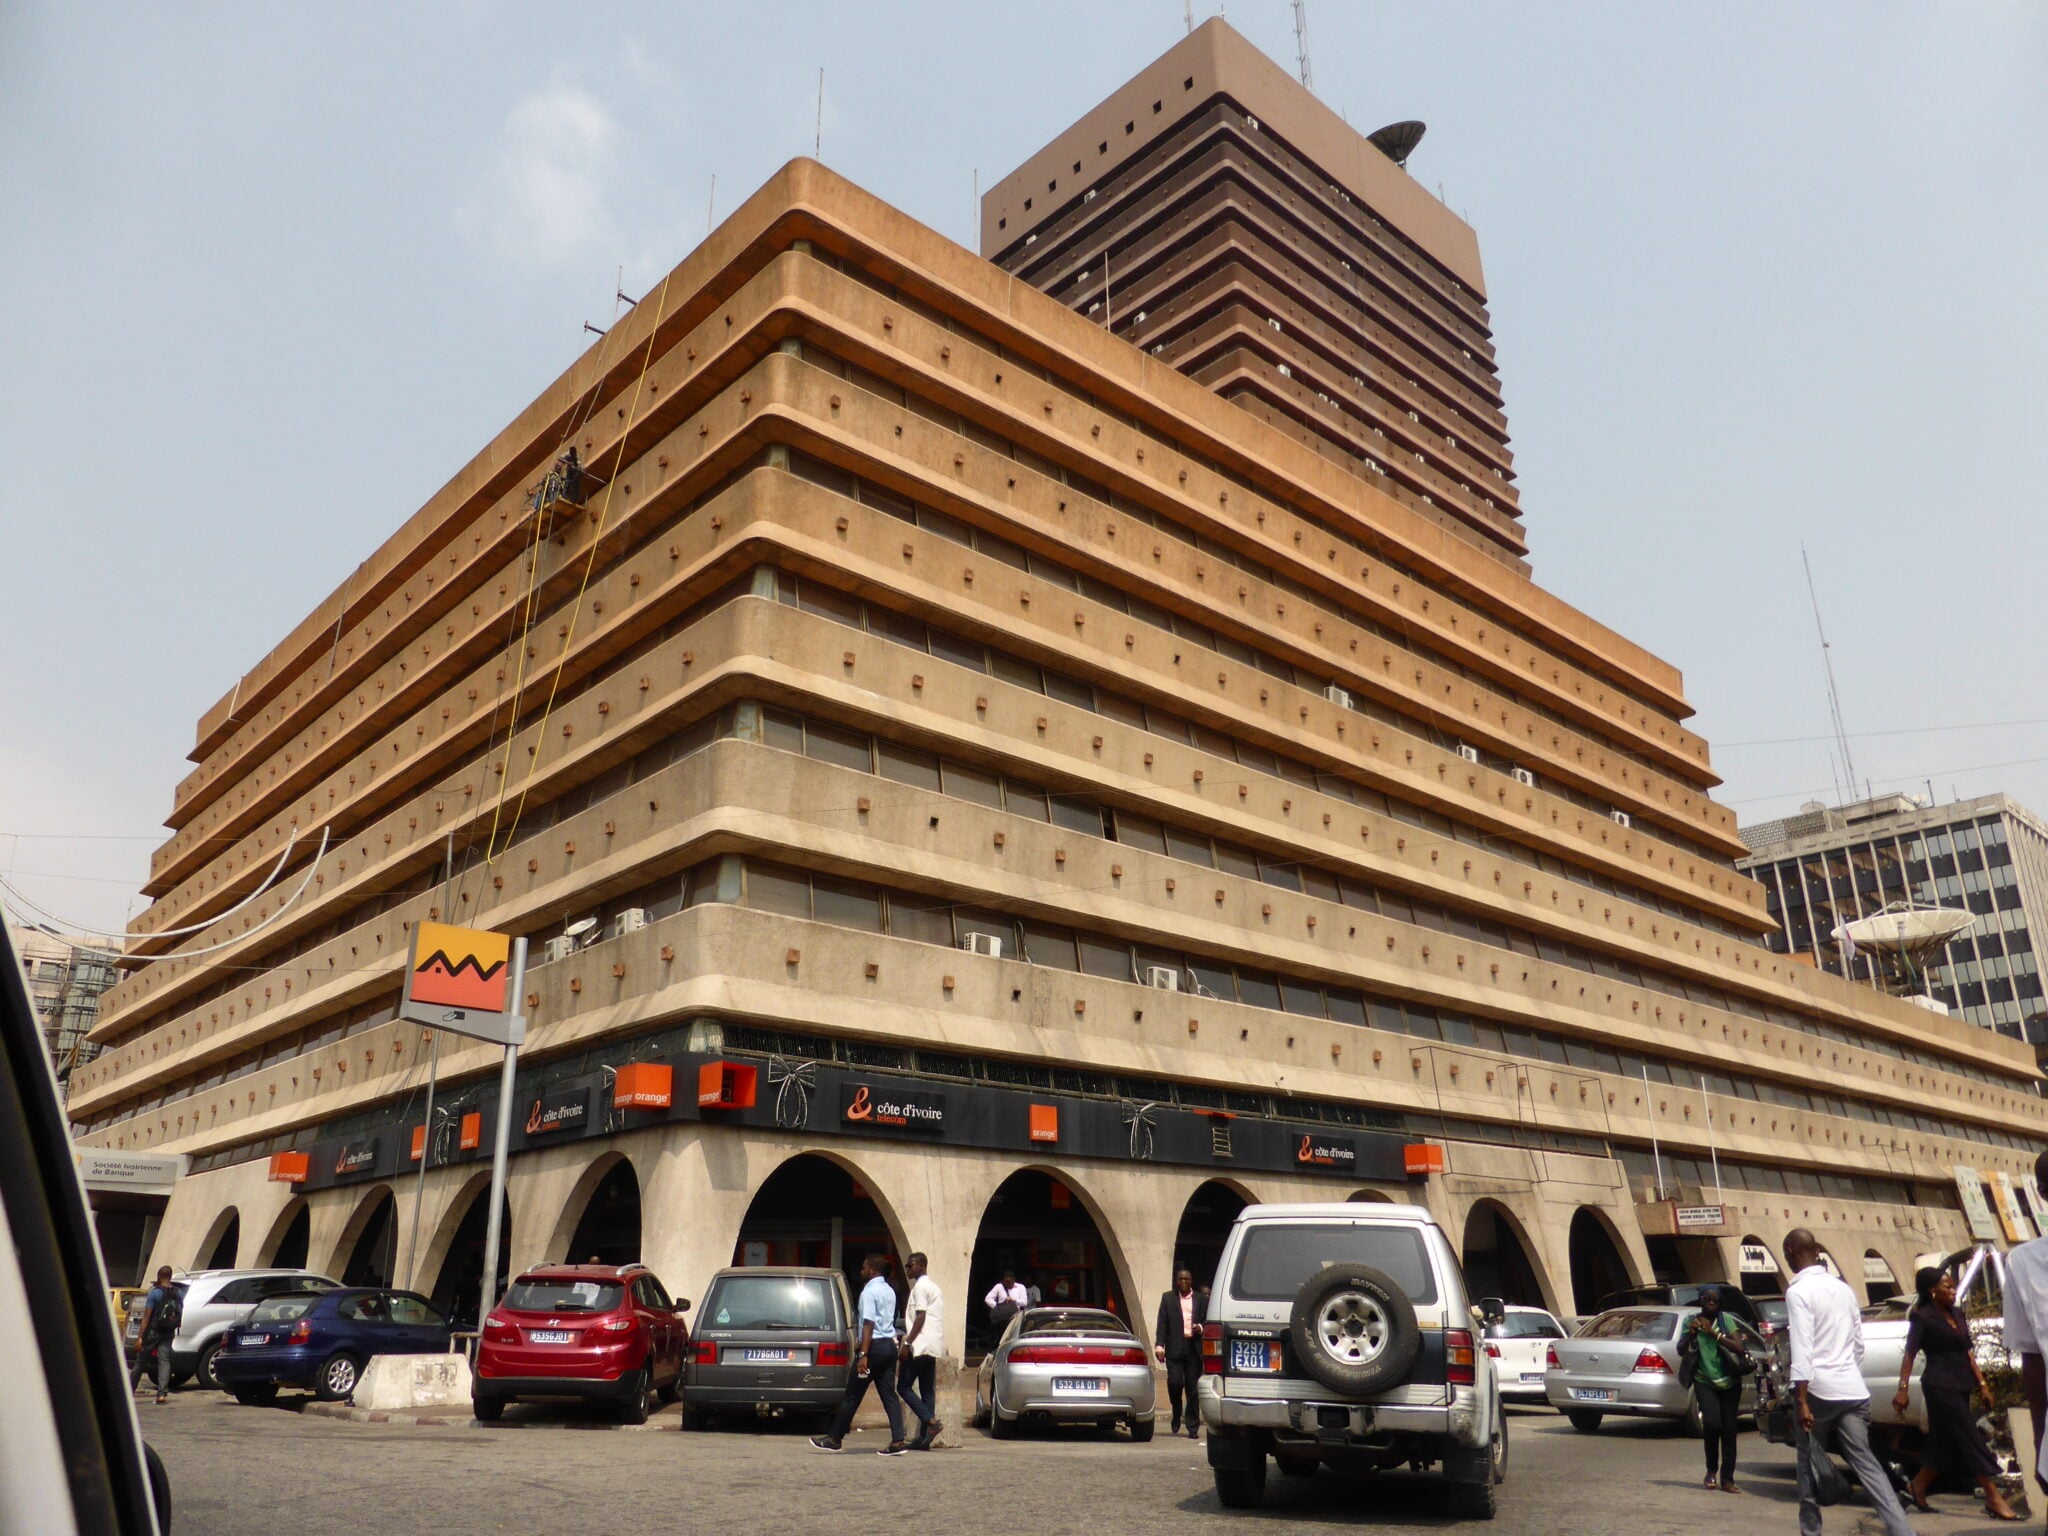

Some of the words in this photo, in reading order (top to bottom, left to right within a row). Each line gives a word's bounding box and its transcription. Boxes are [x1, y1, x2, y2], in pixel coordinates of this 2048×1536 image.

[877, 1102, 900, 1115] côte
[902, 1104, 942, 1120] d'ivoire
[93, 1161, 121, 1169] Société
[104, 1169, 135, 1177] Banque
[1237, 1329, 1272, 1337] PAJERO
[1235, 1341, 1265, 1355] 3297
[1235, 1354, 1265, 1368] EX01
[1058, 1380, 1073, 1389] 532
